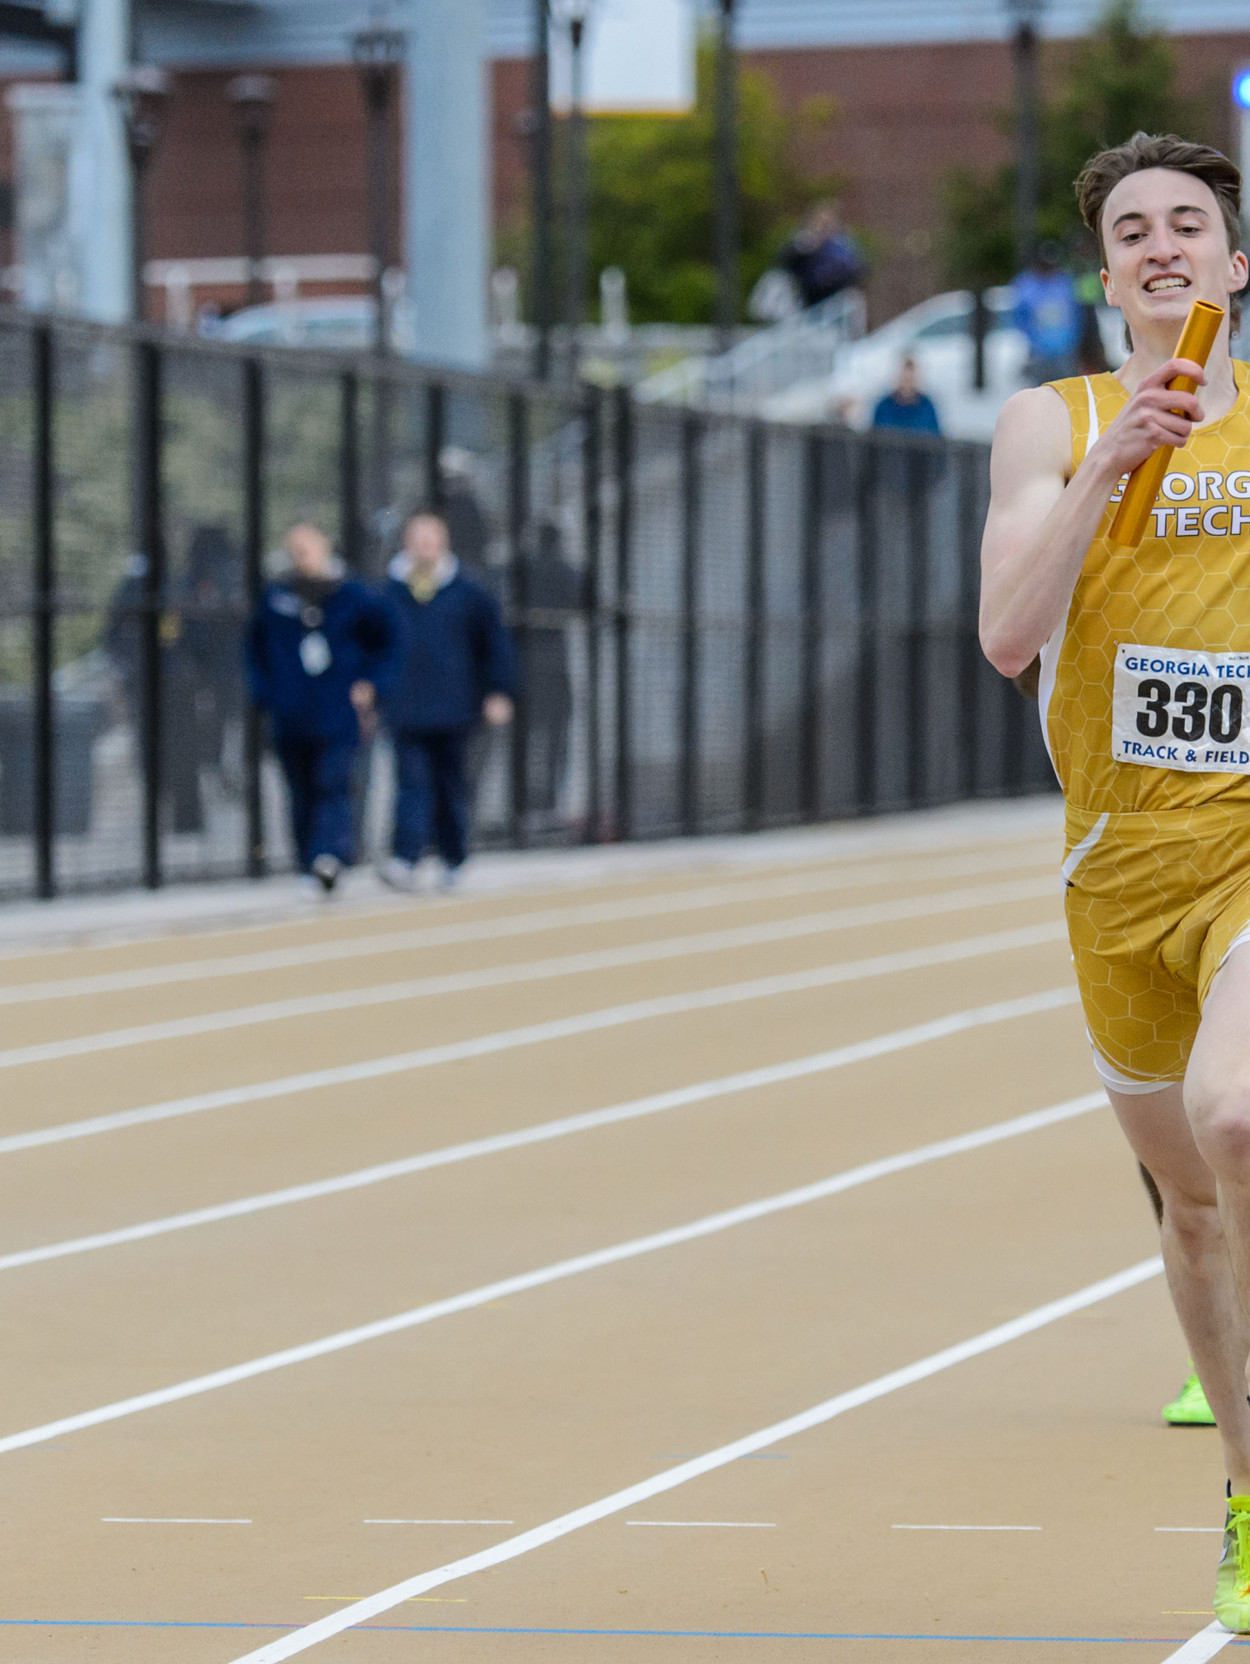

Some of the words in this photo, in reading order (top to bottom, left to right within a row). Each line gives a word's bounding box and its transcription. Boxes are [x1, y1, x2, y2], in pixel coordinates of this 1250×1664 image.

[1125, 657, 1210, 677] GEORGIA
[1136, 679, 1243, 744] 330
[1122, 741, 1179, 761] TRACK
[1185, 749, 1197, 762] &
[1205, 751, 1250, 765] FIELD
